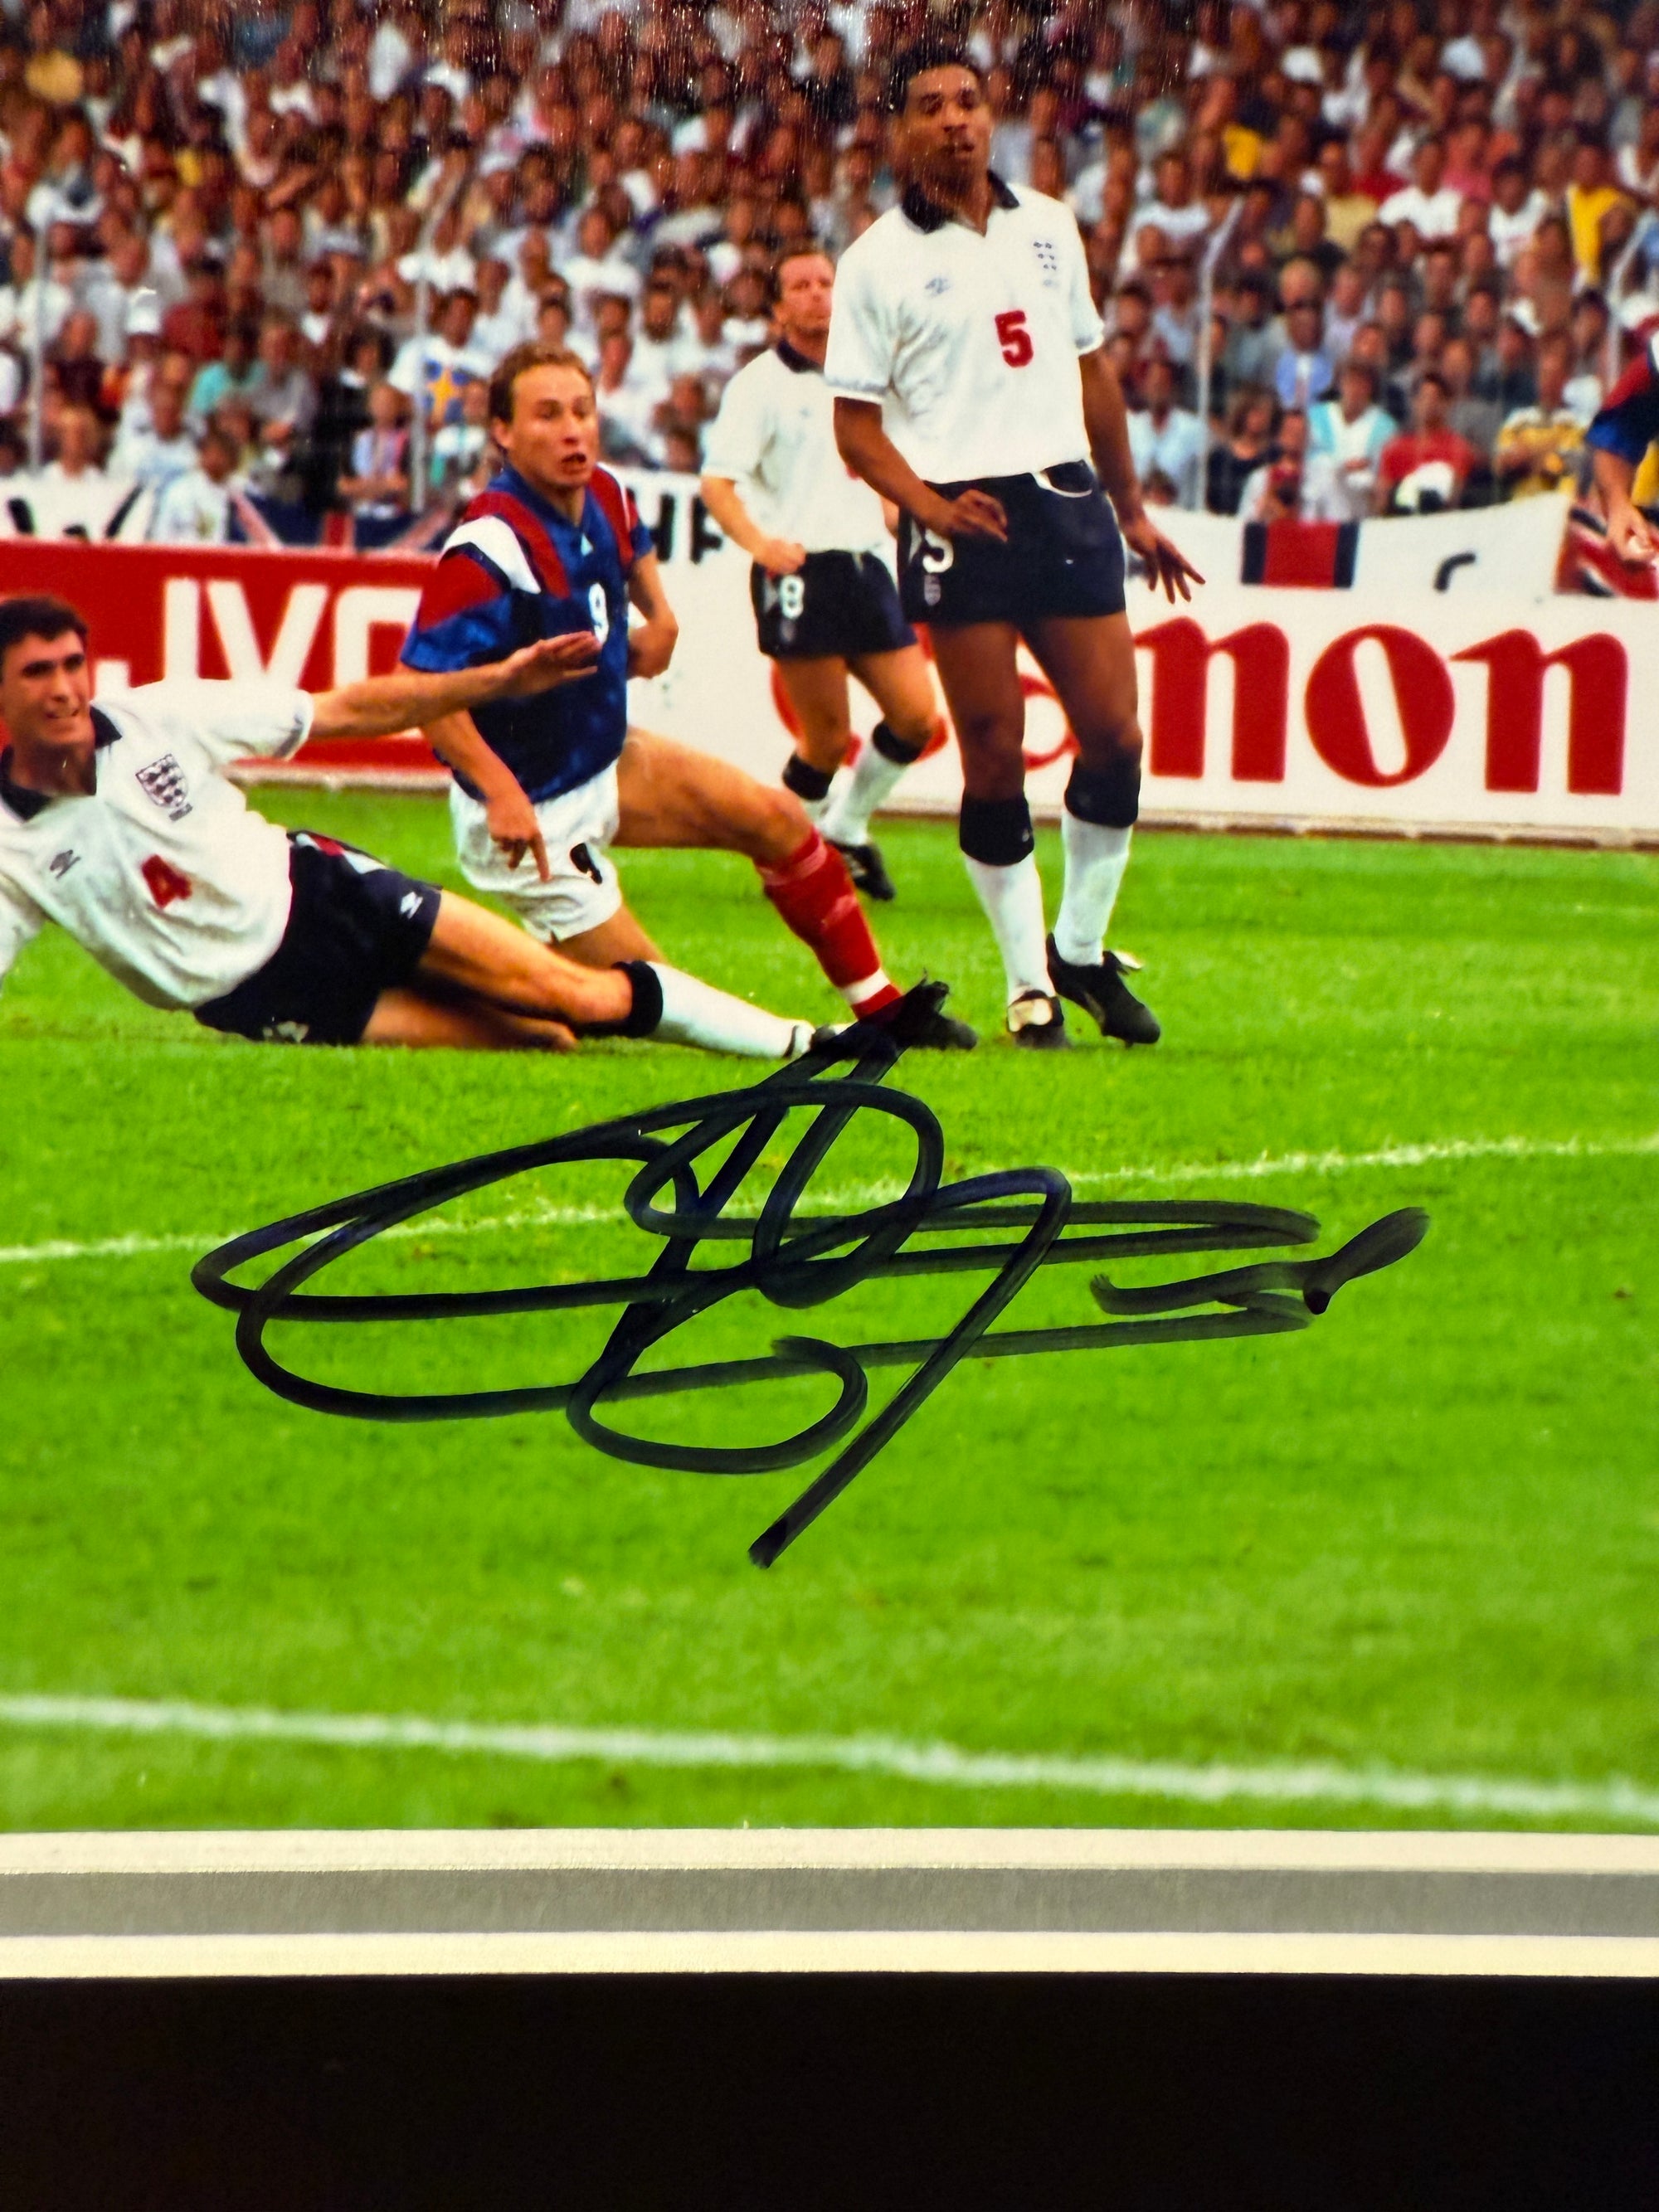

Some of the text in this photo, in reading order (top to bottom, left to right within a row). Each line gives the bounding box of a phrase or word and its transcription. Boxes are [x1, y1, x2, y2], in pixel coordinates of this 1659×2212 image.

[995, 309, 1034, 368] 5
[588, 582, 609, 644] 9
[780, 574, 805, 619] 8
